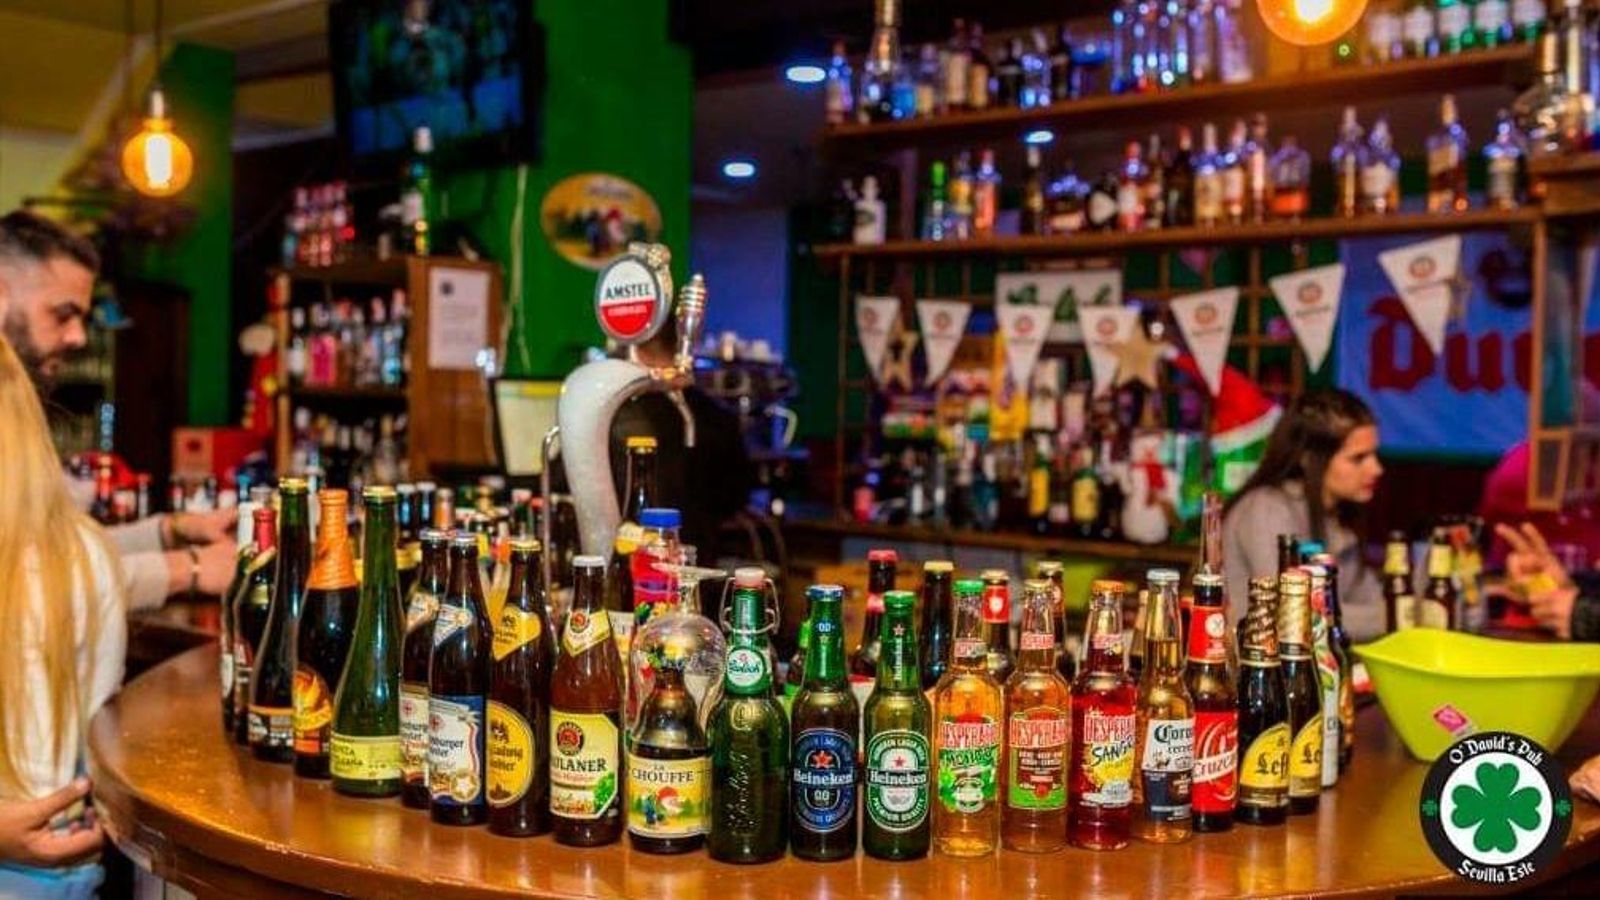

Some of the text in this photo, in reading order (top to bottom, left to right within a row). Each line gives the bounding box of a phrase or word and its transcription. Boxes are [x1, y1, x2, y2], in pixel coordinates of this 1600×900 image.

[606, 283, 649, 299] AMSTEL
[631, 767, 694, 784] CHOUFFE
[793, 766, 854, 785] Heineken
[870, 769, 927, 785] Heineken
